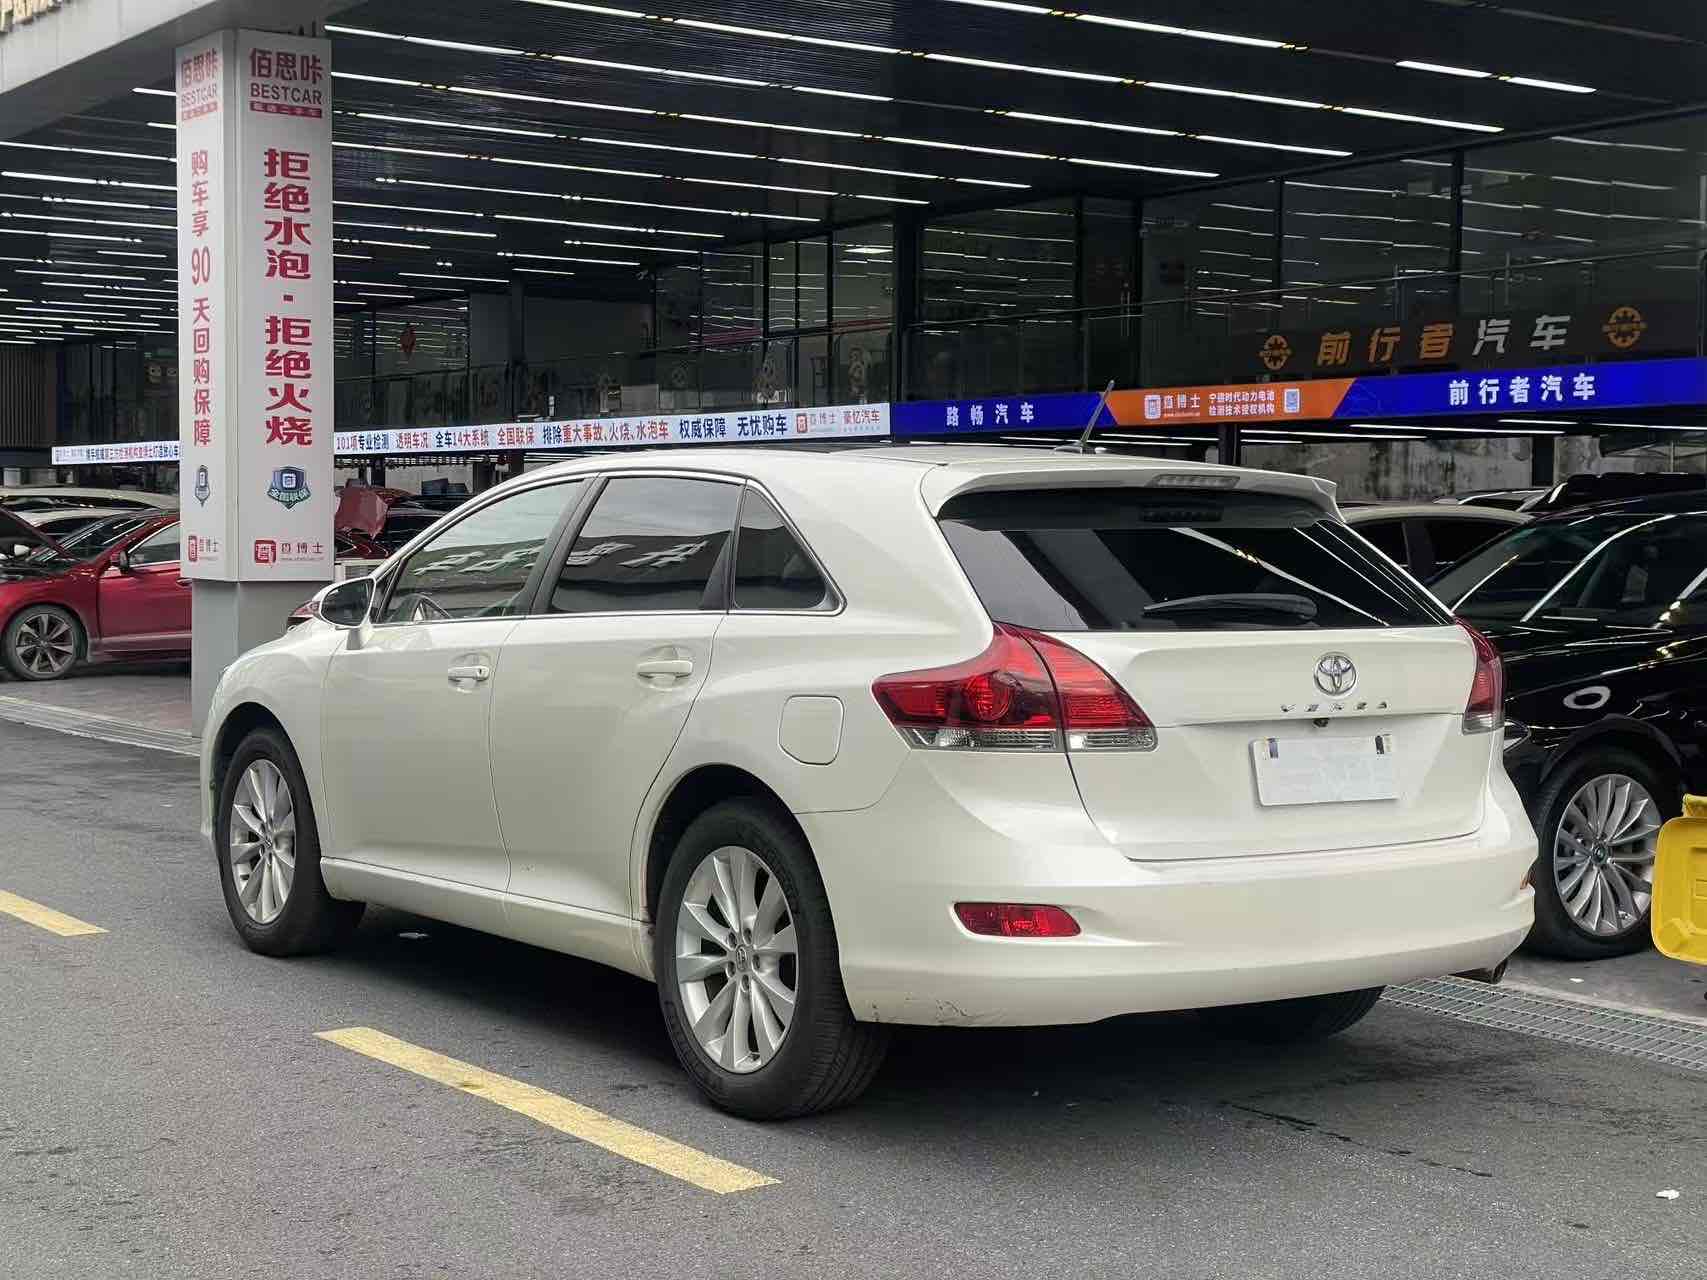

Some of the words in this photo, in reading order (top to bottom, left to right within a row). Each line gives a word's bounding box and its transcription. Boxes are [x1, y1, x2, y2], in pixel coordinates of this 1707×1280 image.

[249, 47, 324, 85] 佰思咔
[250, 83, 323, 105] BESTCAR
[1317, 315, 1571, 367] 前行者汽车
[1449, 373, 1596, 406] 前行者汽车
[497, 426, 534, 446] 全国联保
[680, 418, 727, 439] 权威保障
[737, 414, 788, 436] 无忧购车
[945, 402, 1034, 426] 路畅汽车
